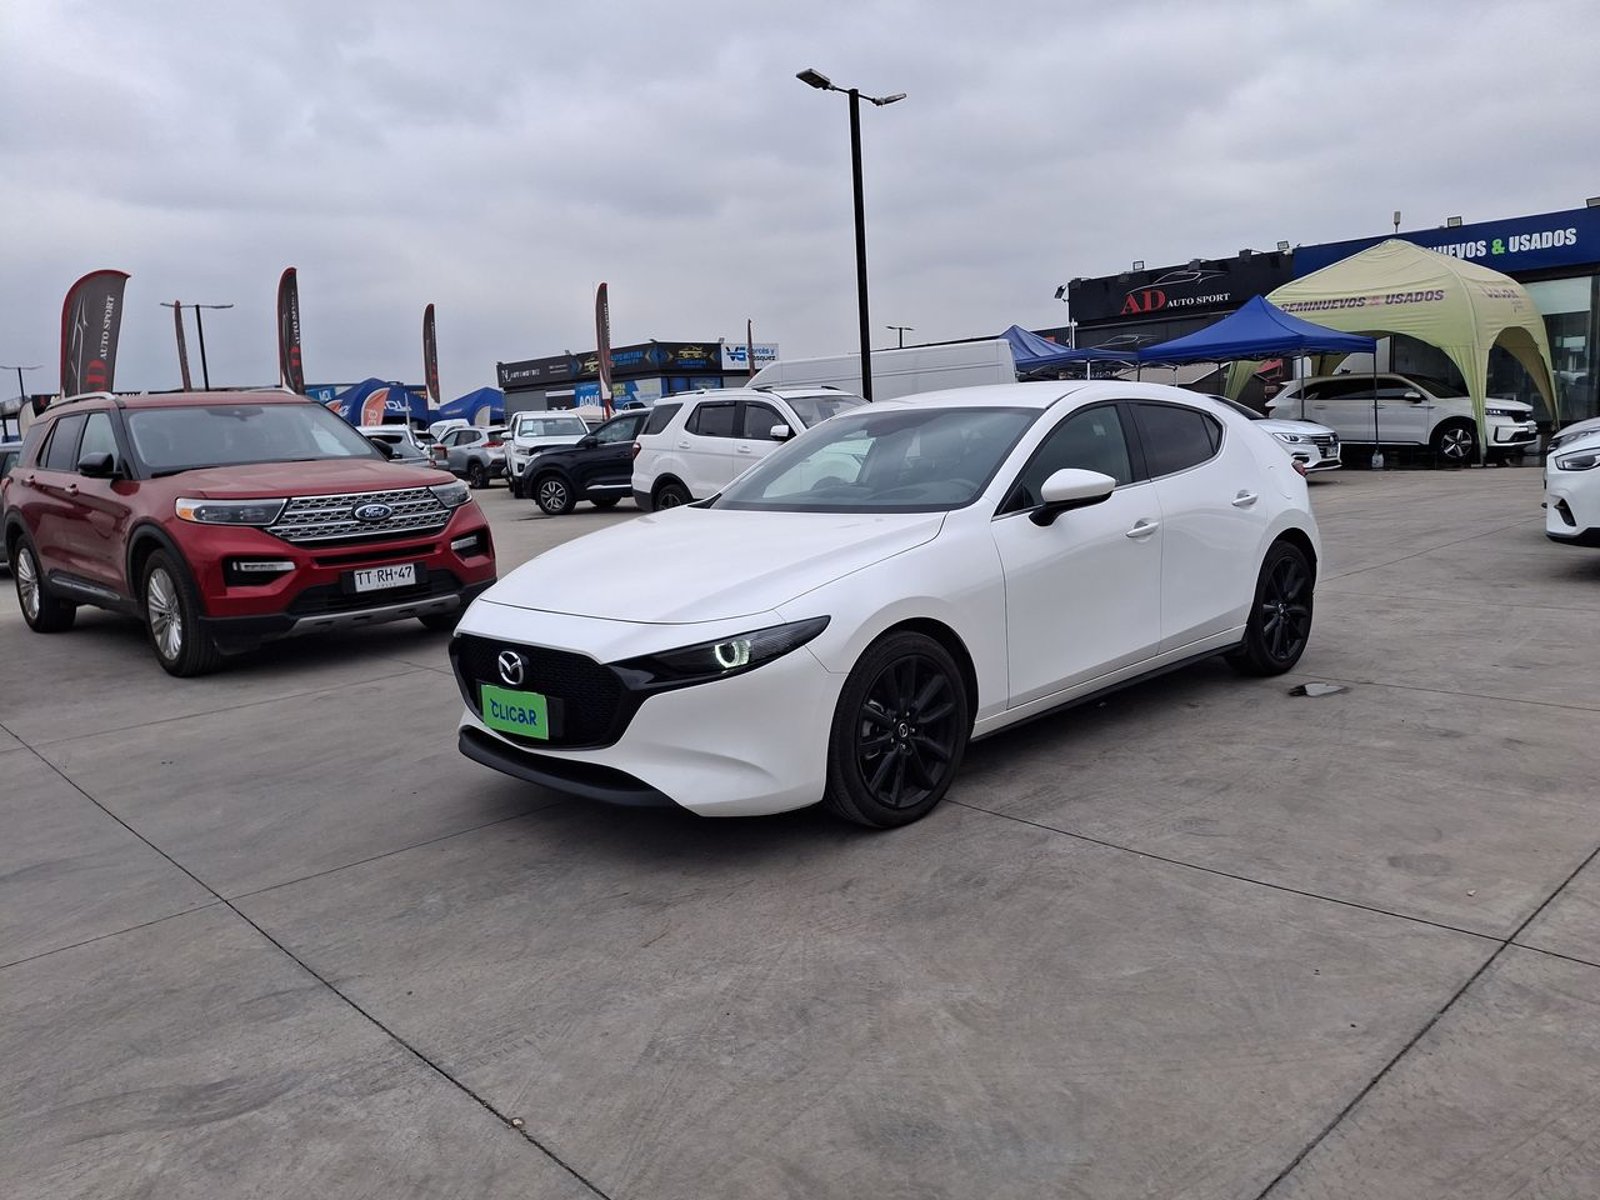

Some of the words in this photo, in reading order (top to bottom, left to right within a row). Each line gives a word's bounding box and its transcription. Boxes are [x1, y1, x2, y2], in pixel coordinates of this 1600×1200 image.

[1491, 238, 1505, 255] &
[1508, 228, 1577, 254] USADOS
[1120, 288, 1167, 316] AD
[1166, 298, 1197, 309] AUTO
[1196, 292, 1232, 305] SPORT
[1385, 289, 1445, 306] USADOS
[103, 294, 115, 331] SPORT
[100, 330, 111, 360] AUTO
[364, 506, 386, 518] Ford
